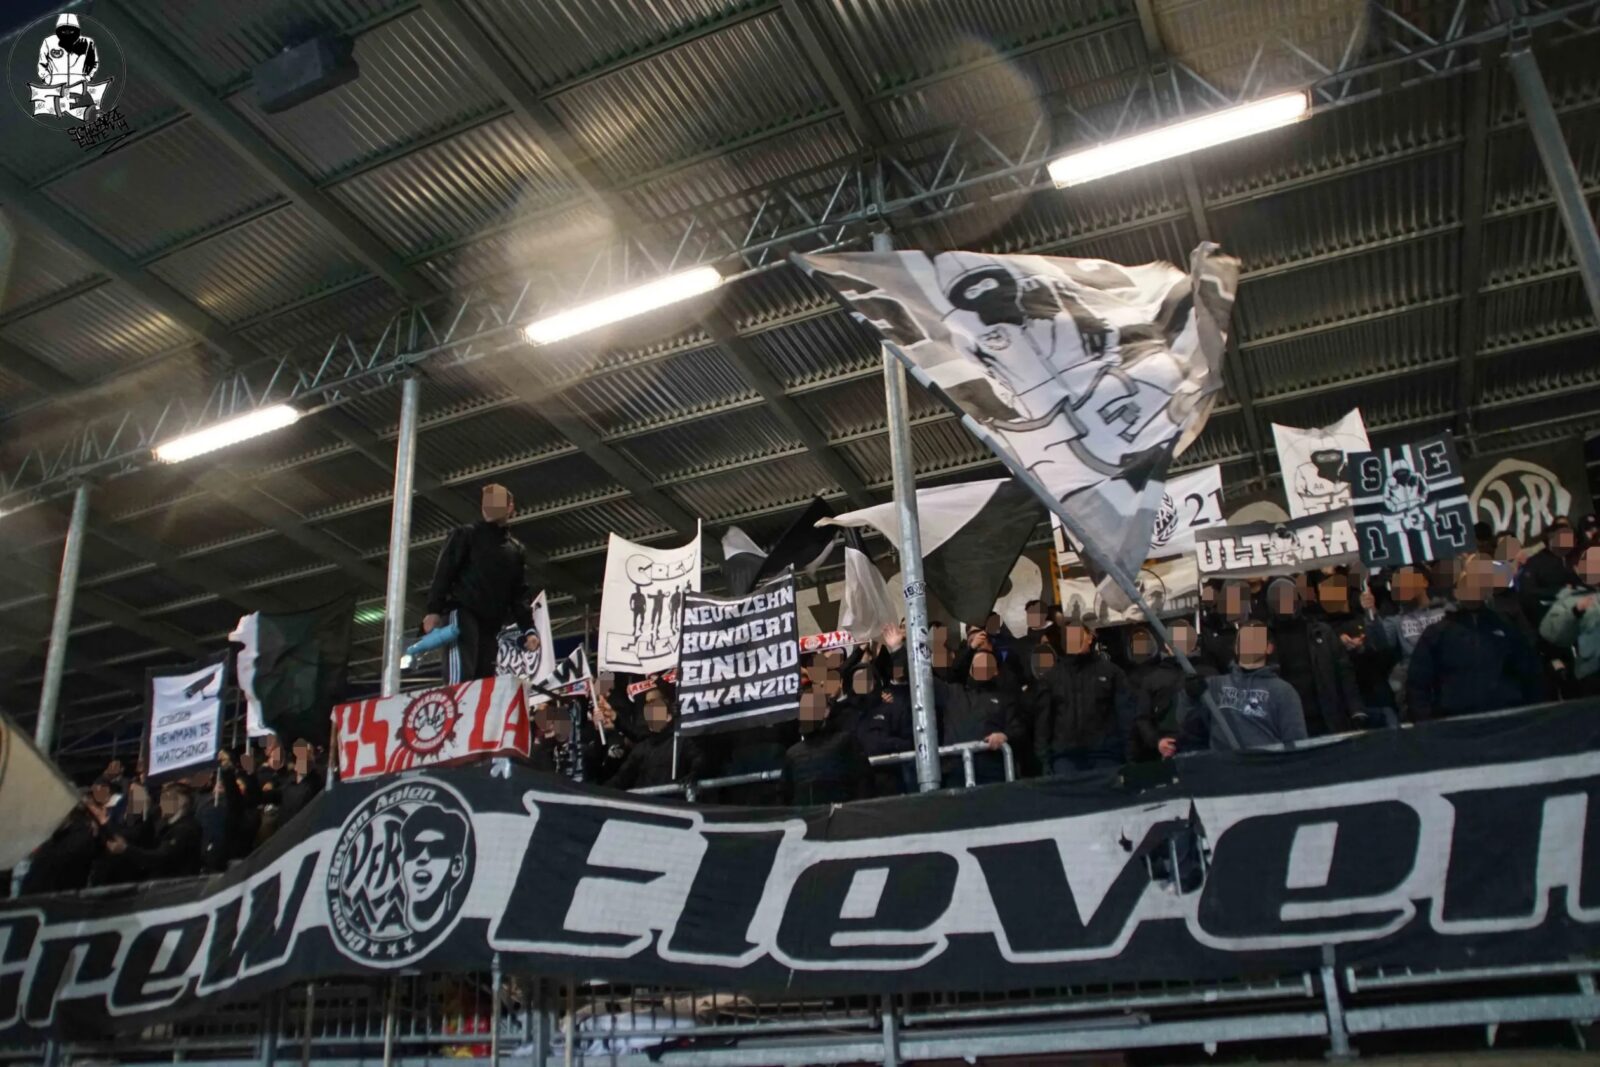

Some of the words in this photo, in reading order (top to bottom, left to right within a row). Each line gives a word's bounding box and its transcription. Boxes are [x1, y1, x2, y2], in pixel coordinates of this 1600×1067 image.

[1184, 487, 1227, 528] 21
[683, 585, 794, 626] NEUNZEHN
[605, 631, 682, 668] ELEV
[682, 611, 795, 655] HUNDERT
[680, 639, 799, 687] EINUND
[678, 672, 799, 716] ZWANZIG
[156, 725, 197, 747] NEWMAN
[200, 721, 211, 737] IS
[375, 784, 437, 812] Aalen
[488, 775, 1600, 972] Eleven
